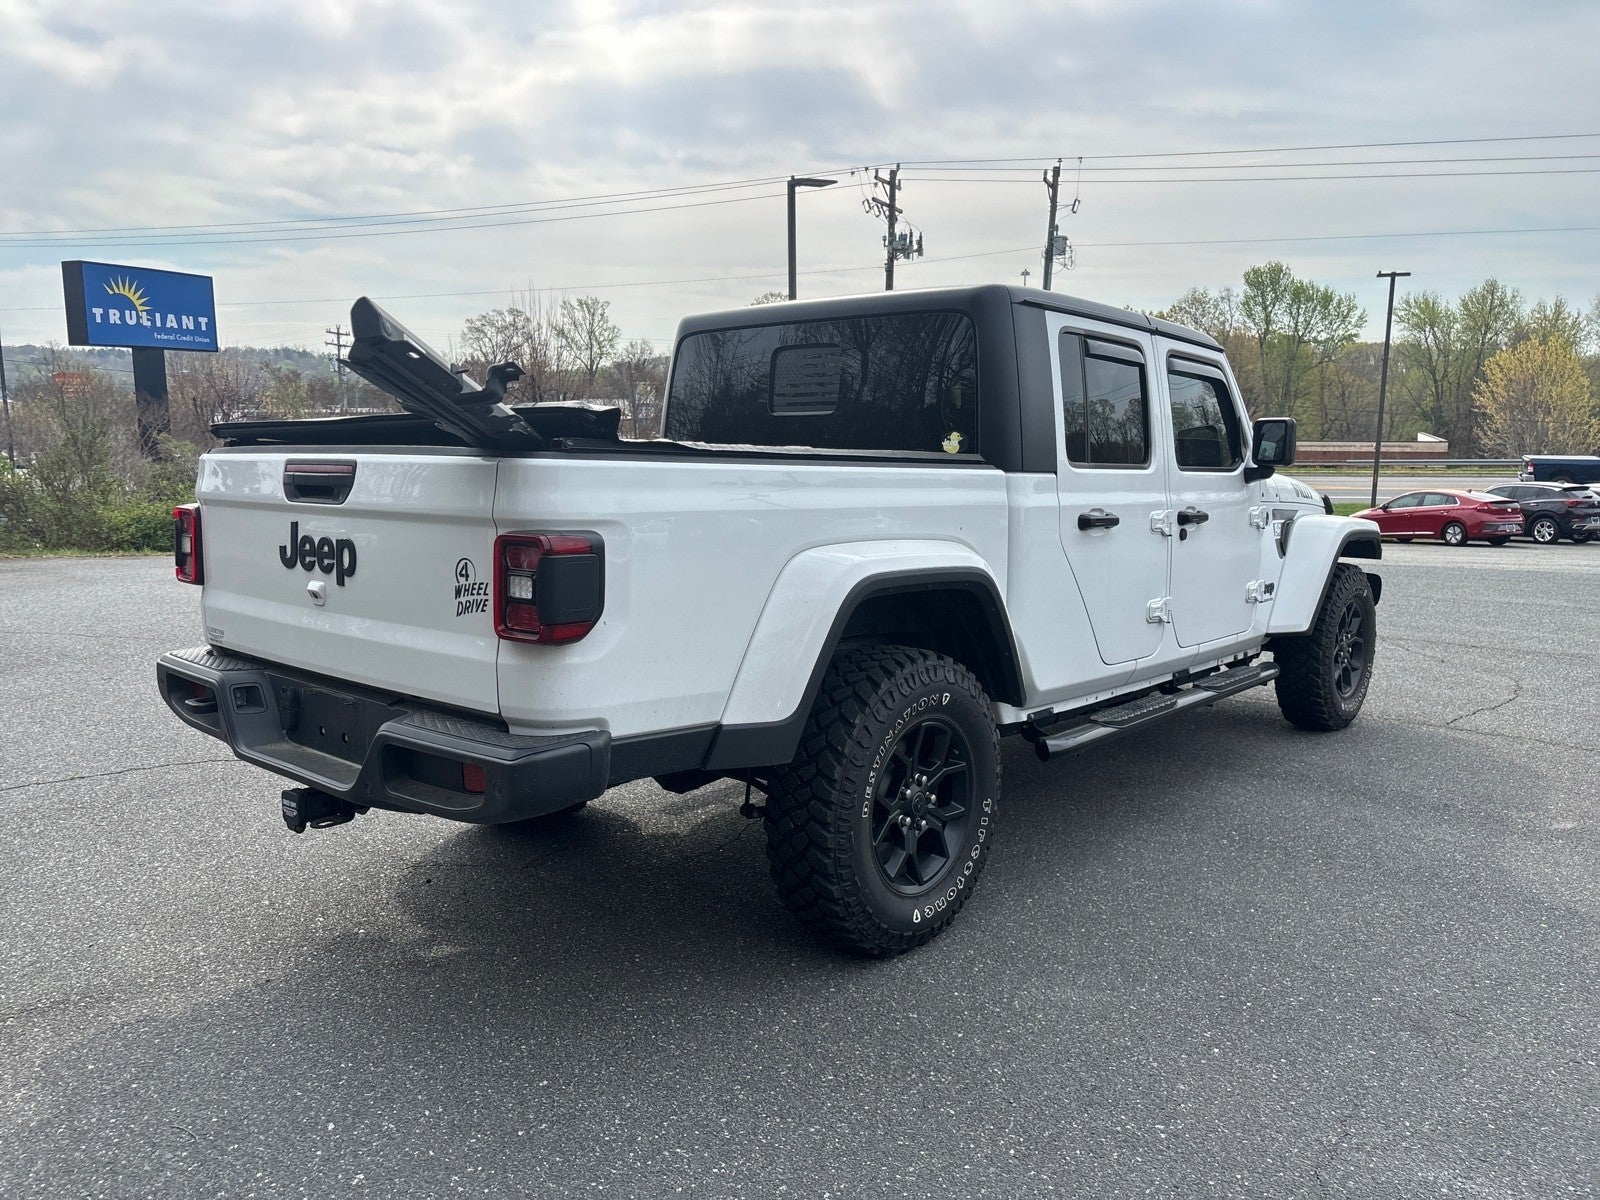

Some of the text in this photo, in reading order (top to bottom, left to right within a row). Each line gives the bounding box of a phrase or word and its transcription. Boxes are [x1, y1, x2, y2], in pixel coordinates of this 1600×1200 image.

[92, 307, 209, 331] TRULIANT
[154, 332, 210, 343] Federal Credit Union
[279, 521, 357, 587] Jeep
[459, 561, 470, 582] 4
[455, 582, 489, 600] WHEEL
[456, 599, 489, 617] DRIVE
[862, 693, 939, 818] DESTINATION
